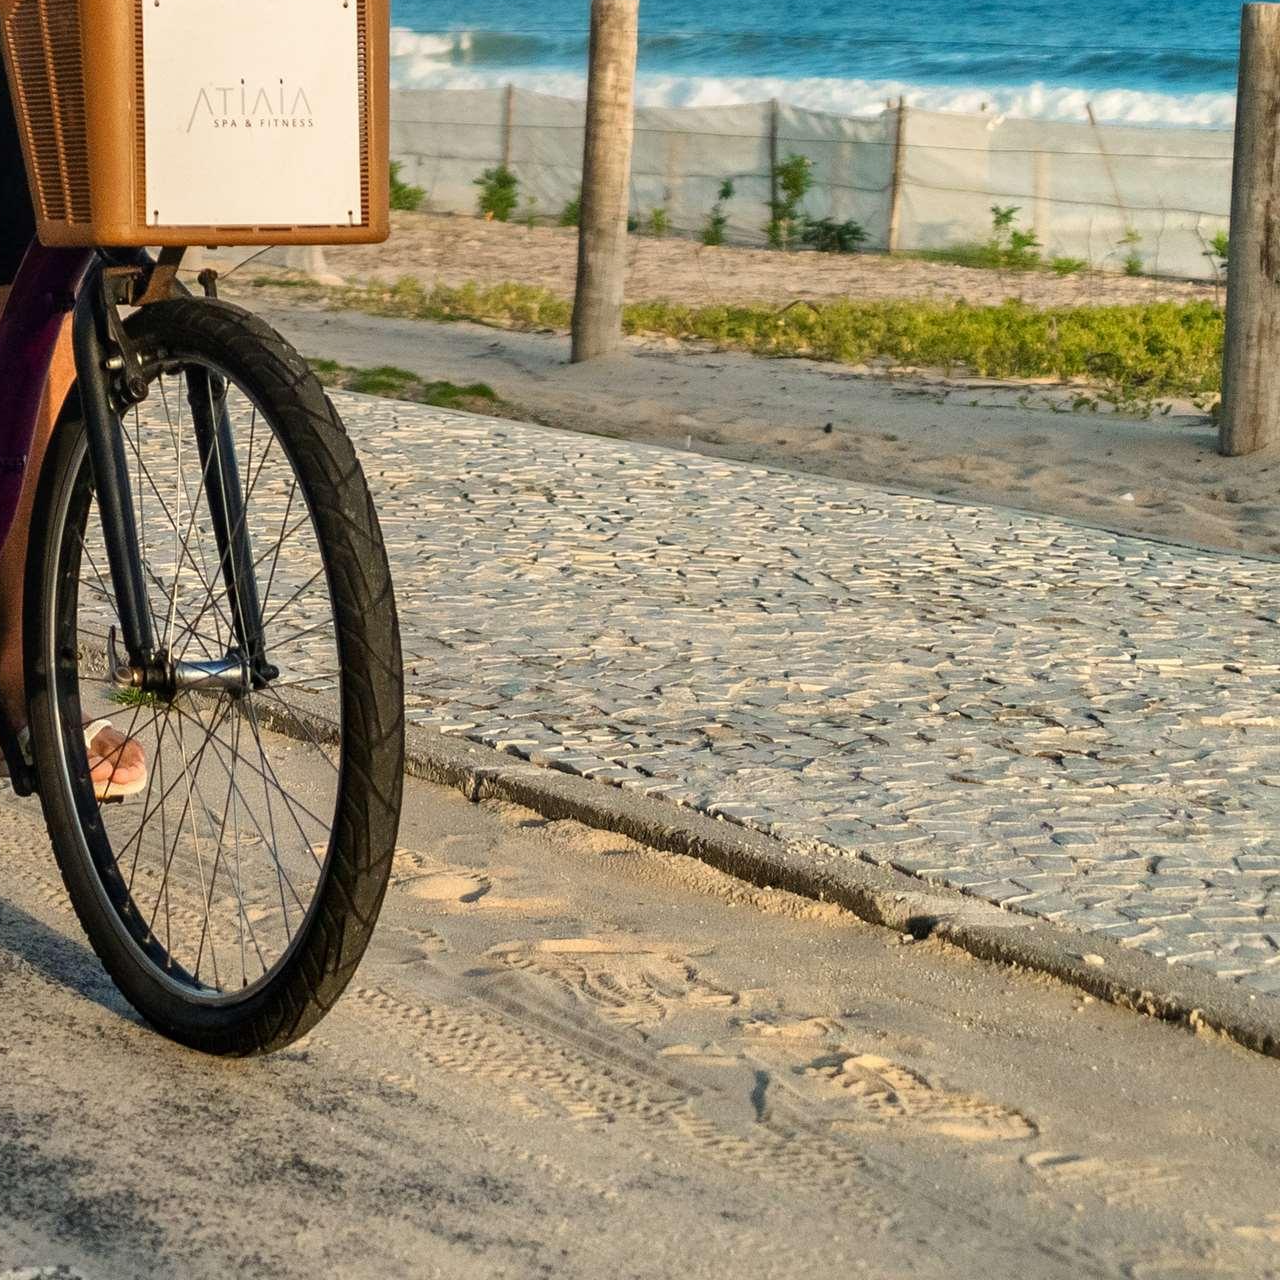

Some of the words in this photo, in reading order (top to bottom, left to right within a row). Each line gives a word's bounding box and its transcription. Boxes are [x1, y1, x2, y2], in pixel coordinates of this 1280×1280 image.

[213, 119, 237, 128] SPA
[244, 119, 253, 128] &
[259, 118, 314, 128] FITNESS
